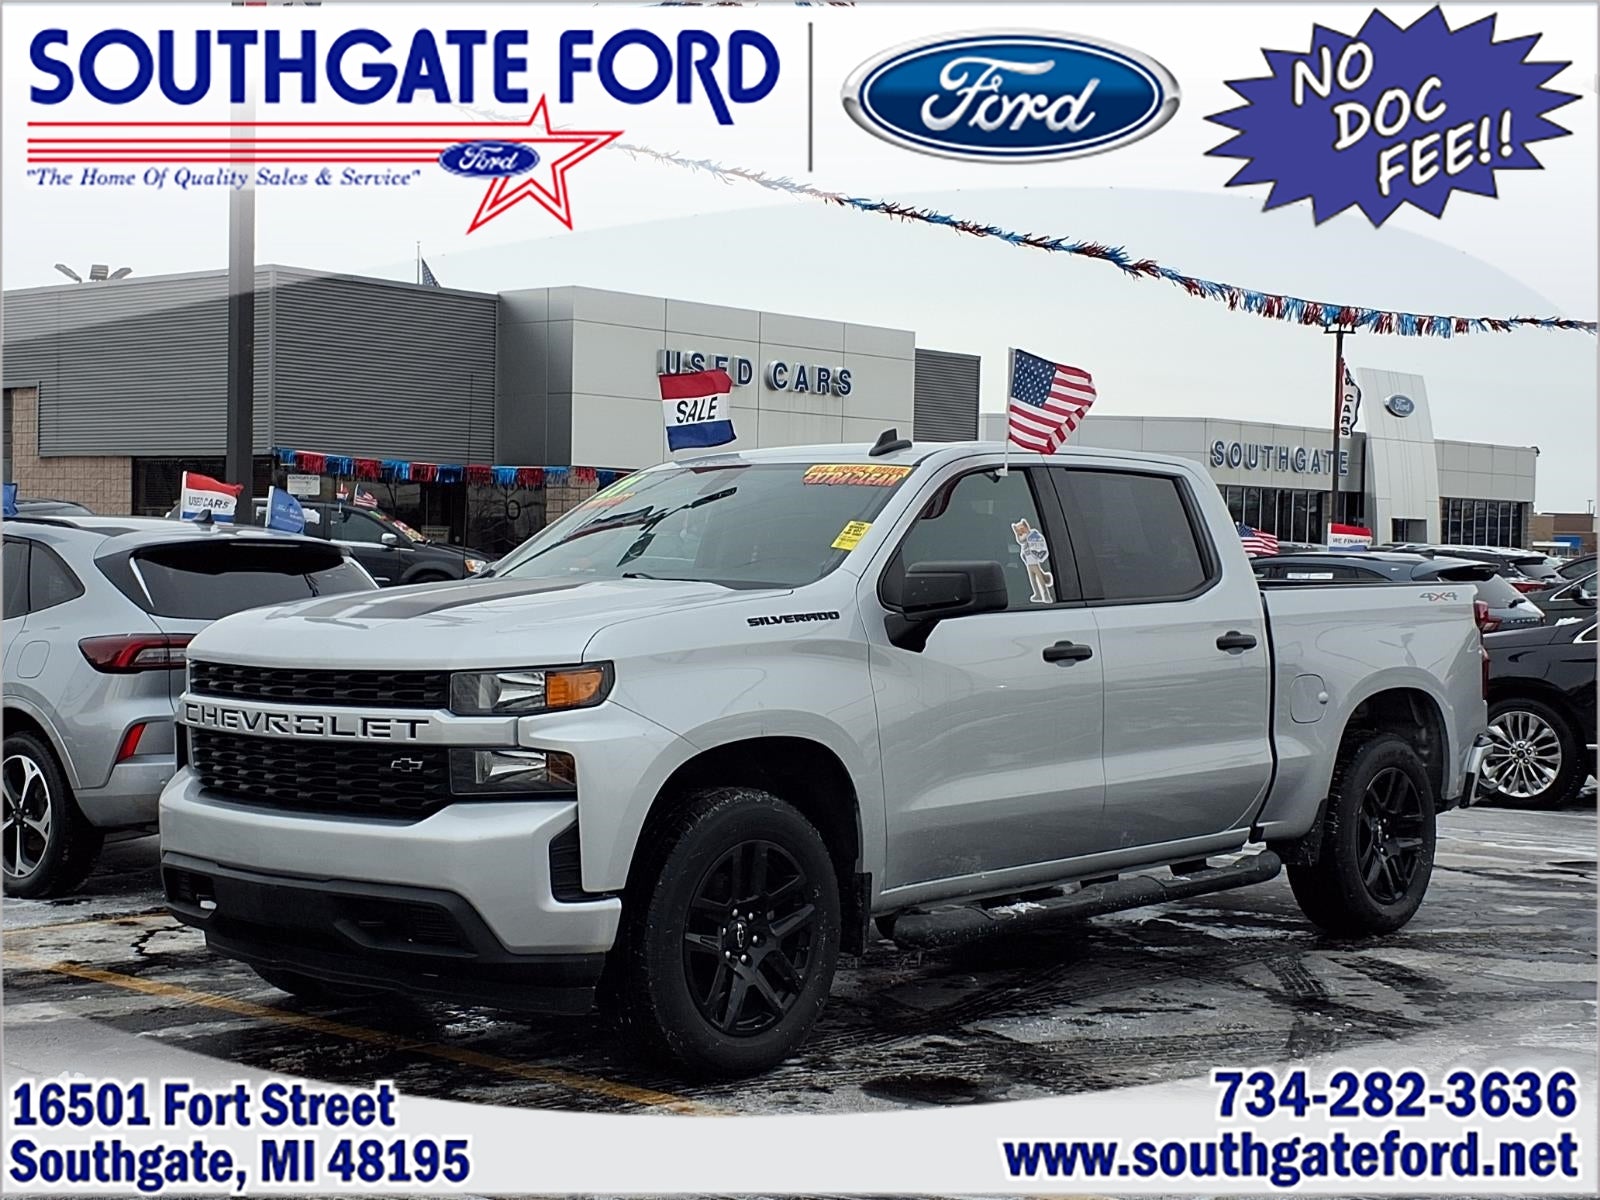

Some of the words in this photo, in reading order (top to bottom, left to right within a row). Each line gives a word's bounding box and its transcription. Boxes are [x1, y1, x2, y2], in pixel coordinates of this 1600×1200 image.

[665, 349, 753, 386] USED
[772, 361, 852, 396] CARS
[675, 396, 718, 424] SALE
[1340, 393, 1354, 436] CARS
[1211, 440, 1349, 476] SOUTHGATE
[848, 472, 902, 487] CLEAN
[746, 611, 841, 627] SILVERADO
[185, 703, 430, 741] CHEVROLET
